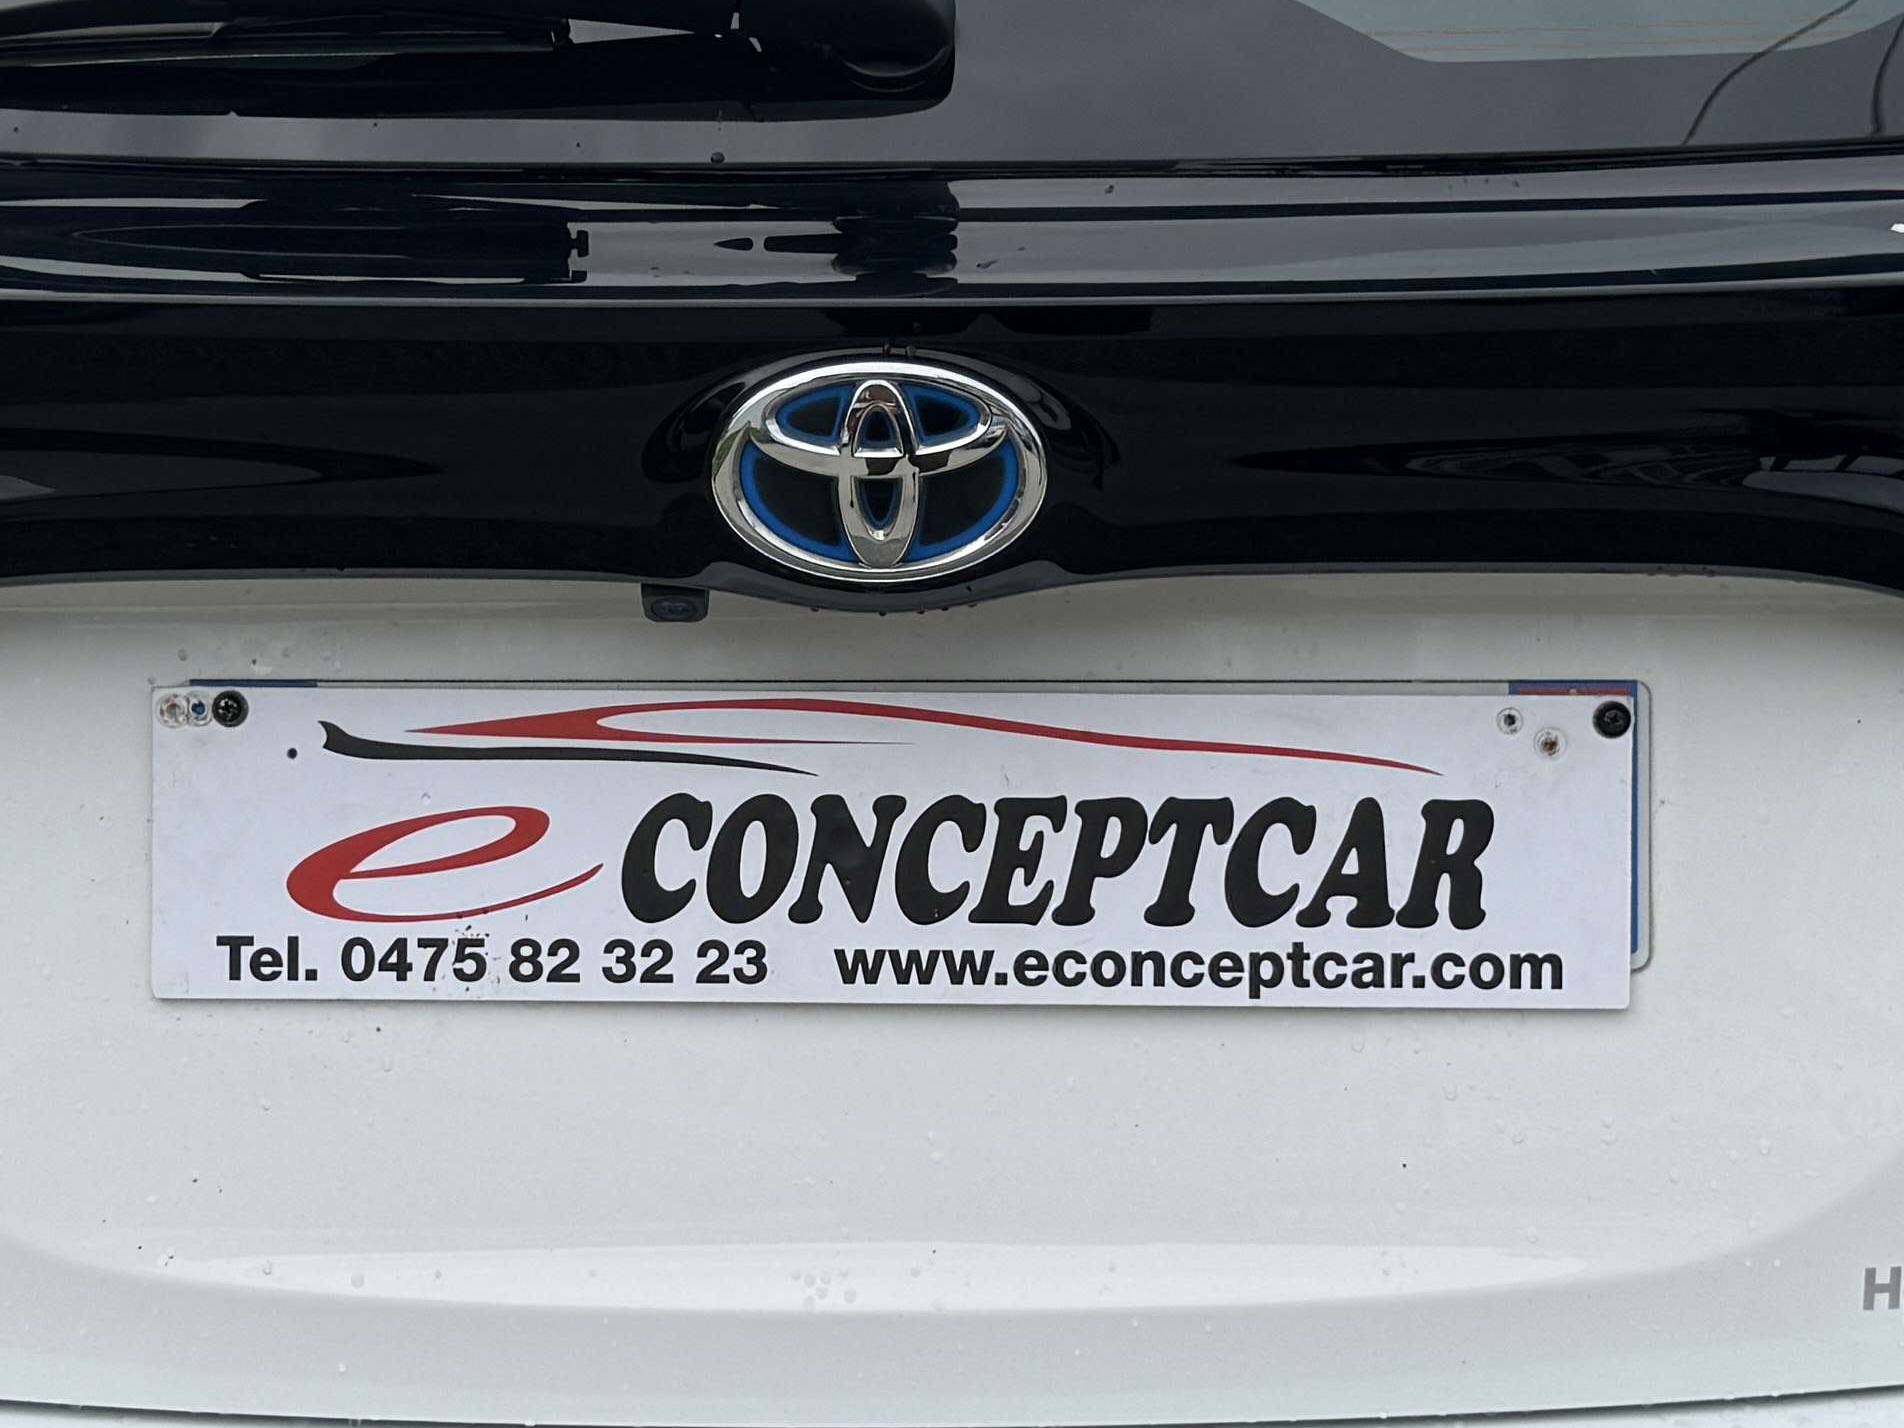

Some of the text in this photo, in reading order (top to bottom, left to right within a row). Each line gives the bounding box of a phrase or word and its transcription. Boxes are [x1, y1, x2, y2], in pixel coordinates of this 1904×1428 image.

[622, 793, 1494, 930] CONCEPTCAR
[217, 936, 1562, 999] Tel. 0475 82 32 23 www.econceptcar.com
